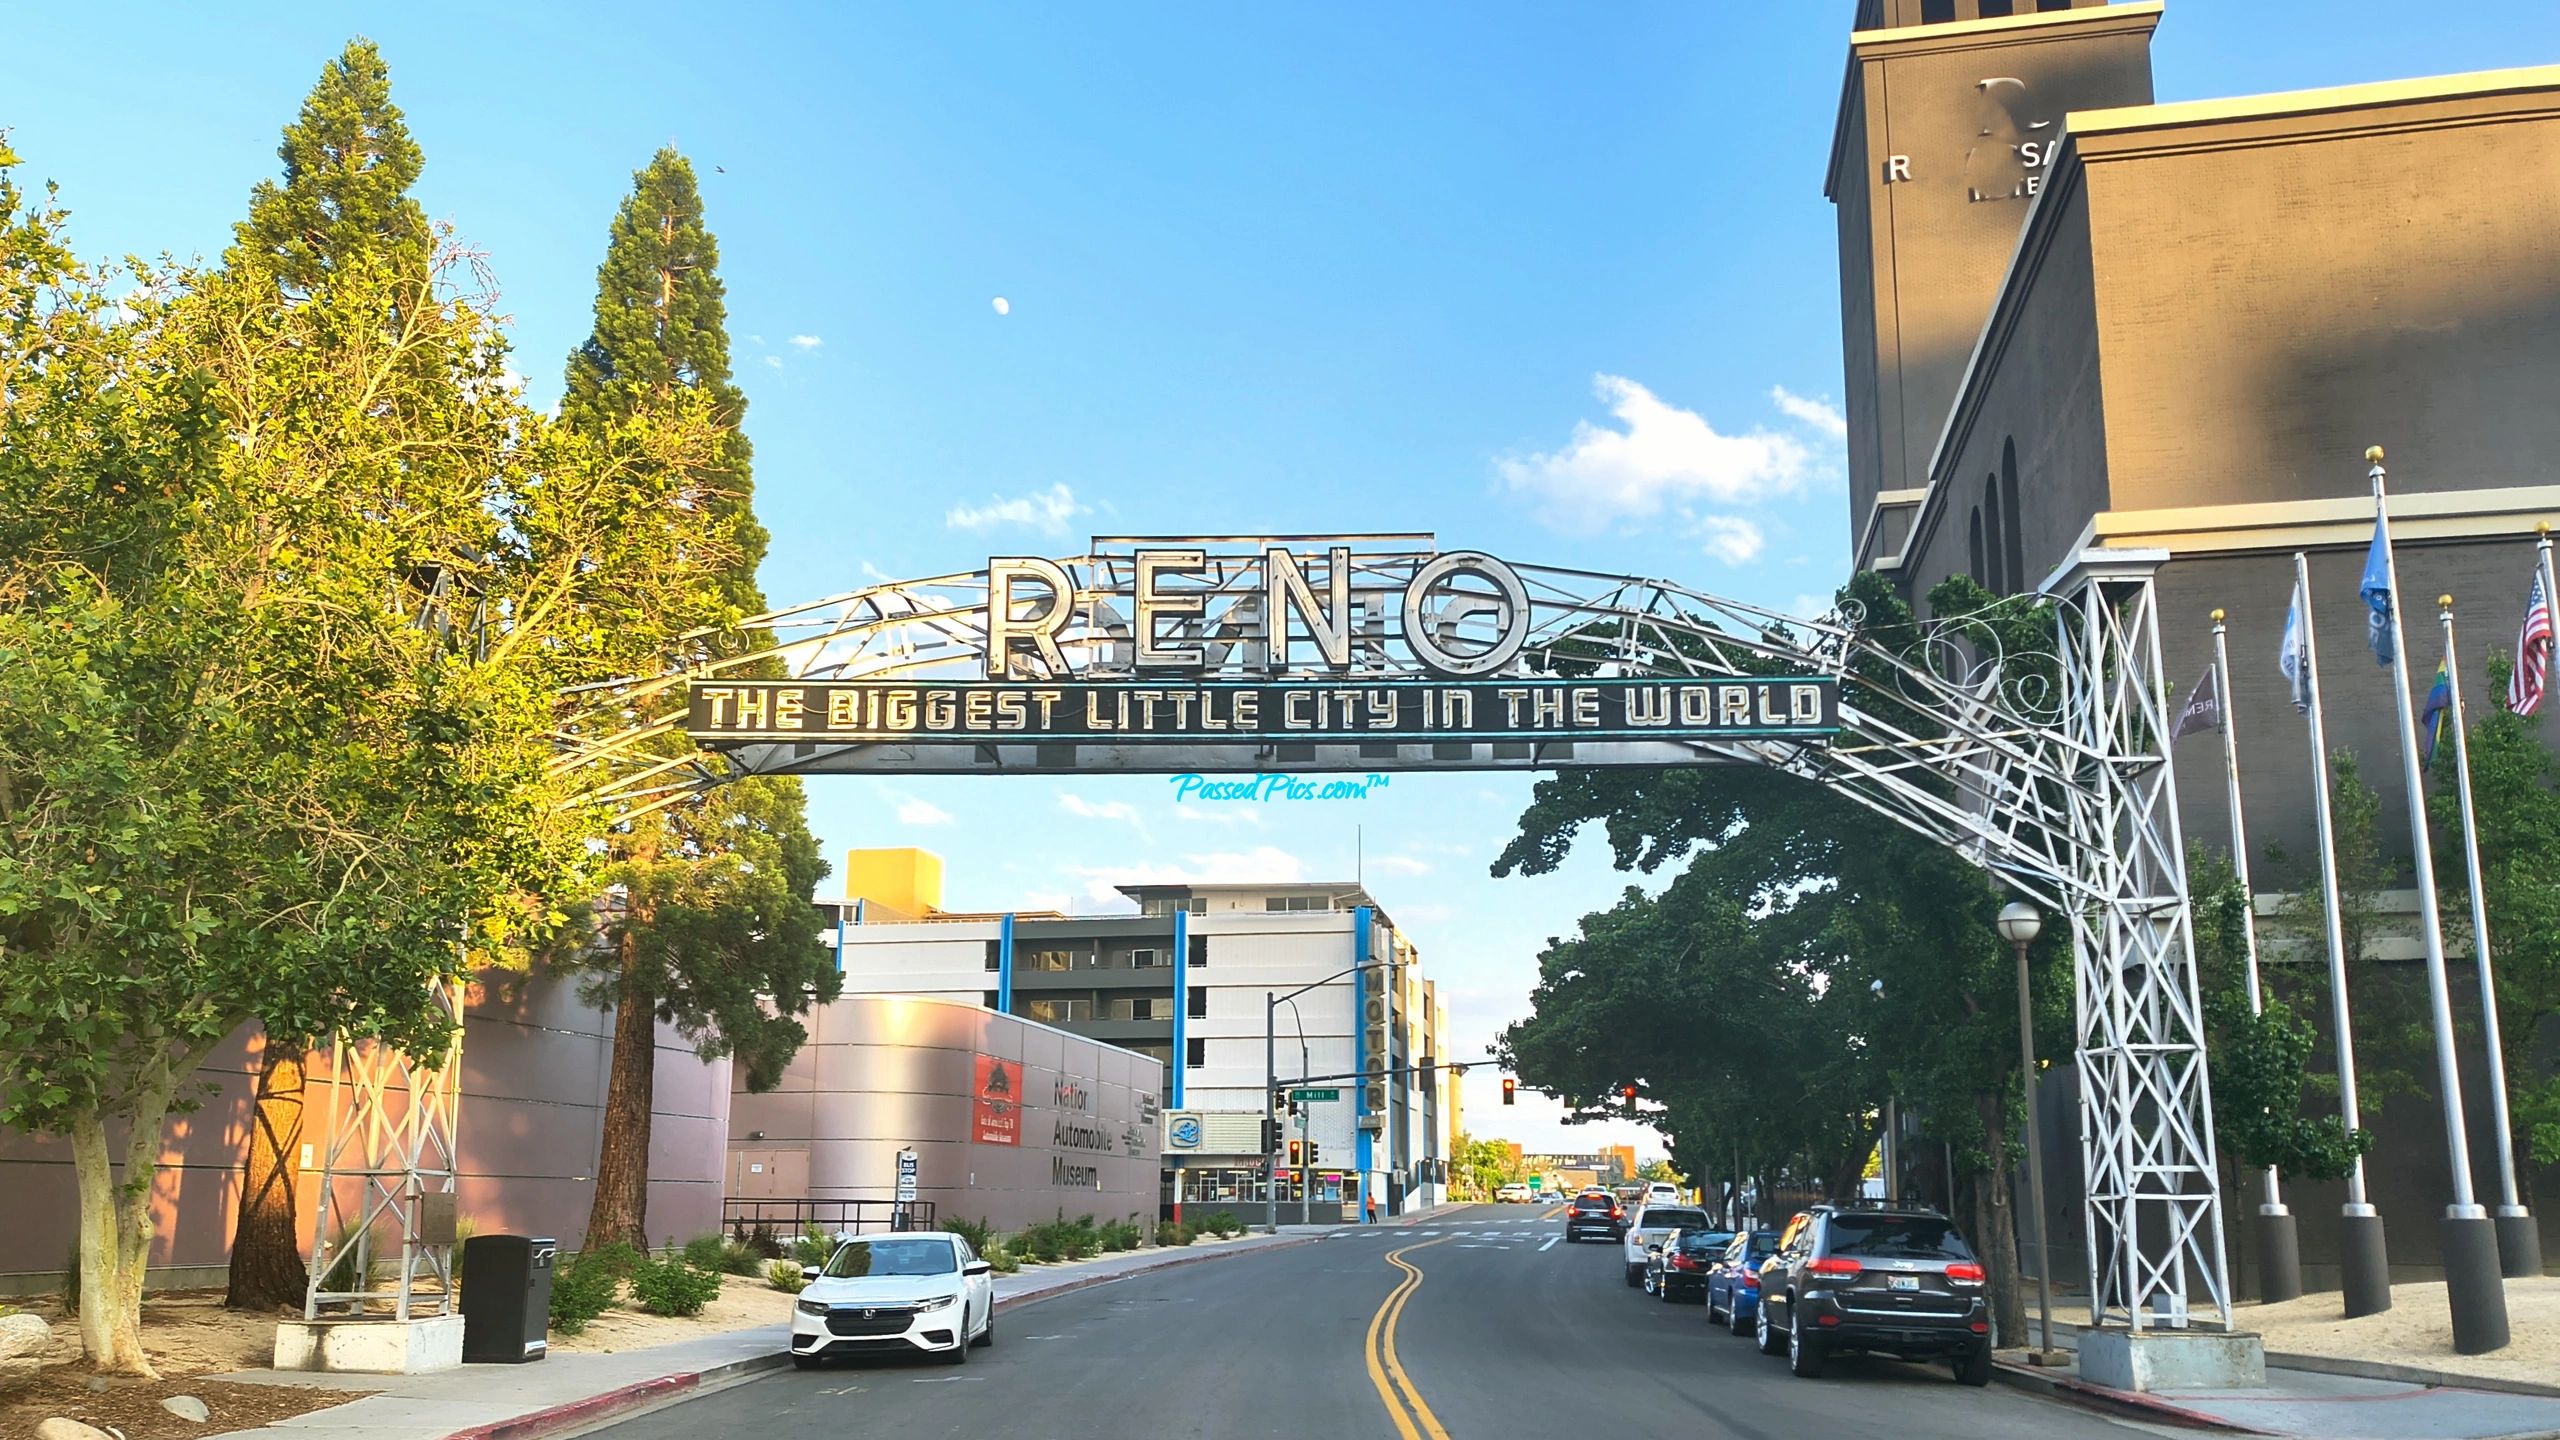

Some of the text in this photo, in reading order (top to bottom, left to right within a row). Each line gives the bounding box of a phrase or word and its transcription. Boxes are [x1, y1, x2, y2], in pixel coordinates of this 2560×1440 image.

[988, 548, 1531, 681] RENO
[701, 684, 1822, 730] THE BIGGEST LITTLE CITY IN THE WORLD
[1364, 970, 1385, 1111] MOTOR
[1306, 1091, 1325, 1099] Mill
[1053, 1119, 1113, 1152] Automobile
[1052, 1156, 1098, 1187] Museum
